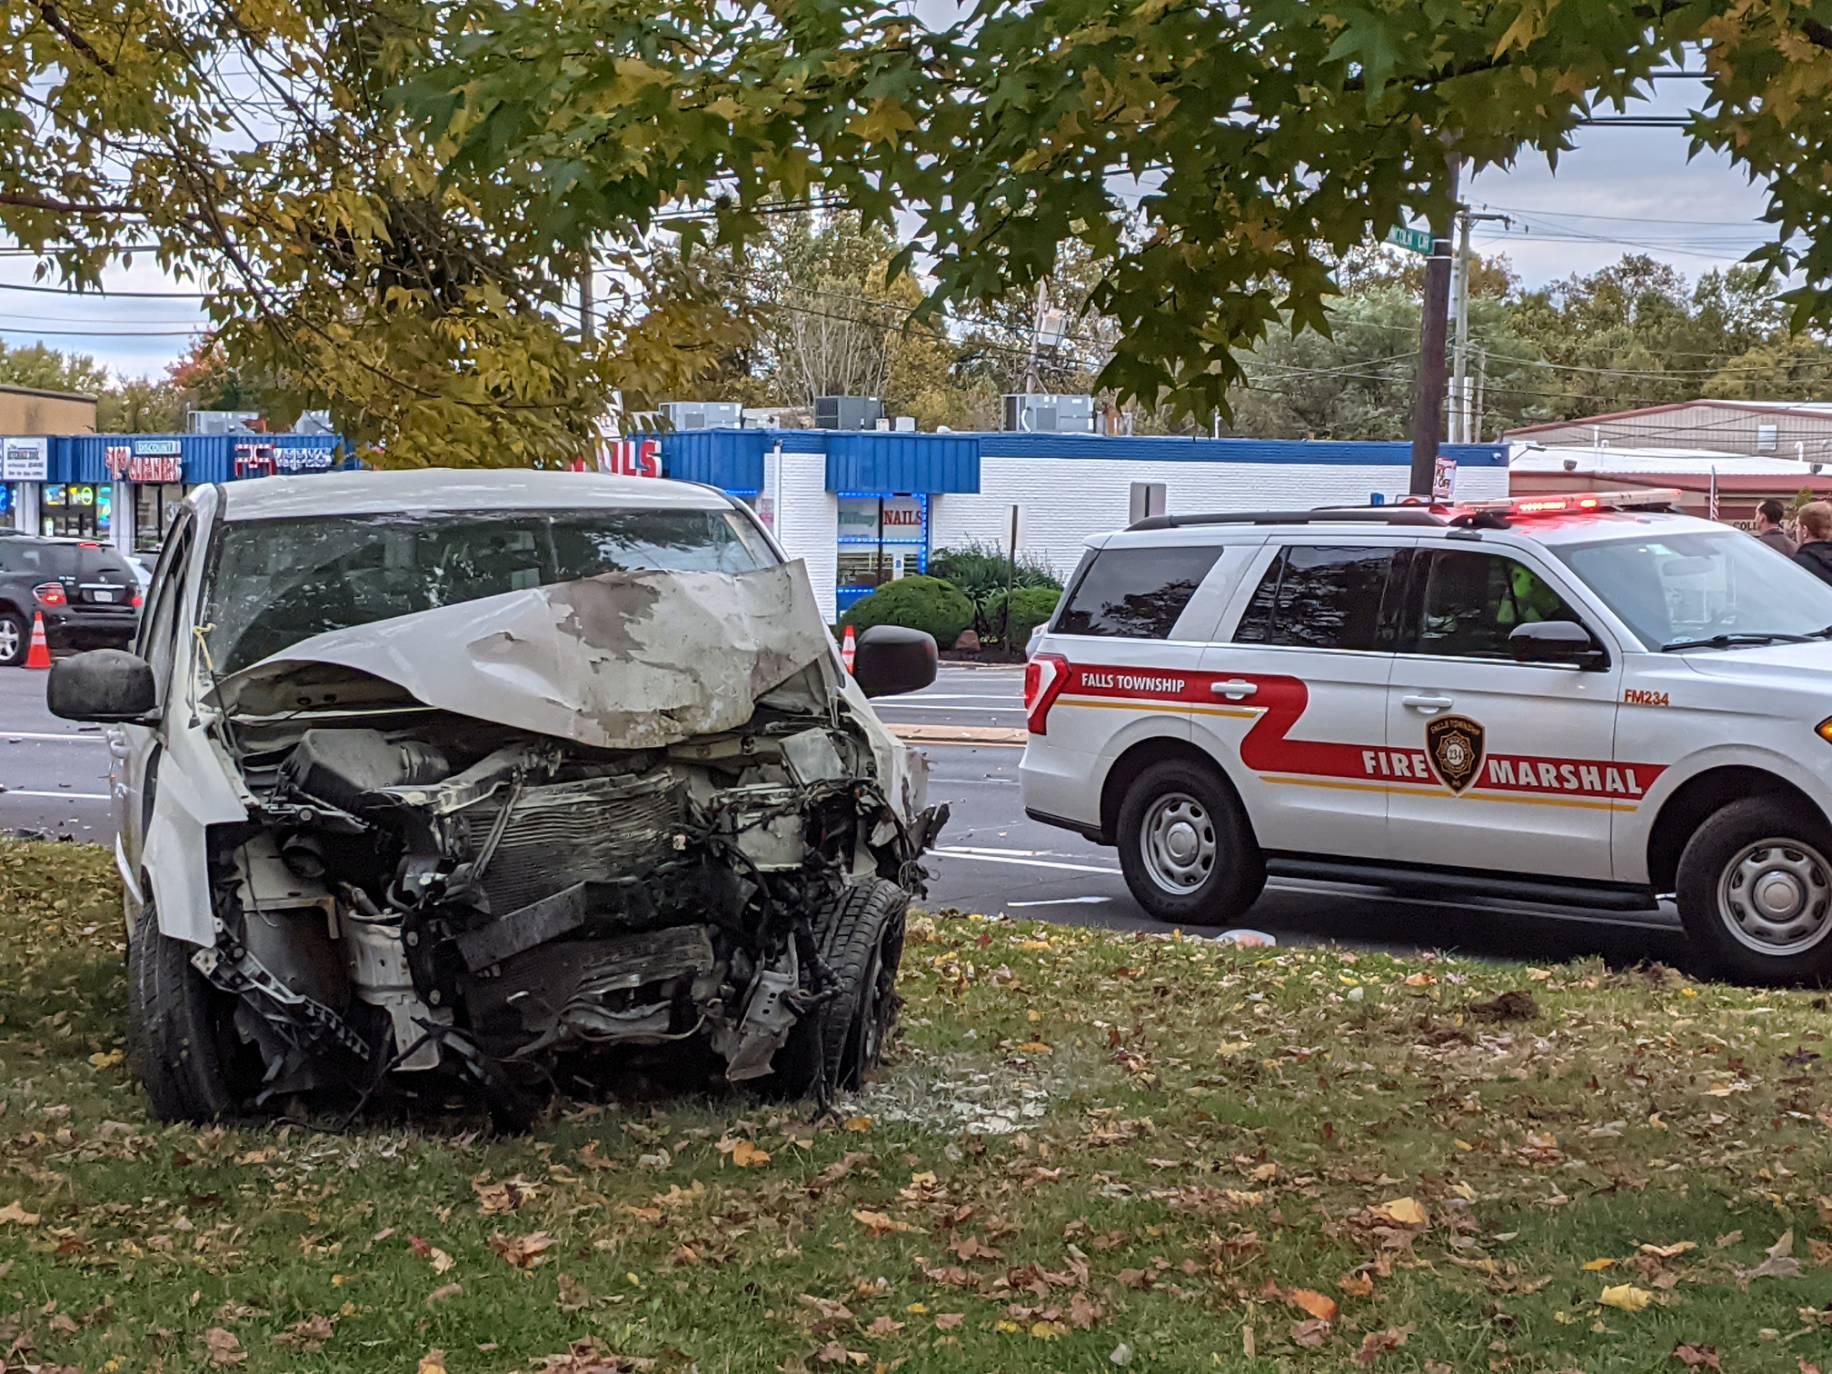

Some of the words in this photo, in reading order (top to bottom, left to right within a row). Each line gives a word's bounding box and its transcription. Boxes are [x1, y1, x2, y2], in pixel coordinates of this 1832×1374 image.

[883, 510, 922, 526] NAILS
[1732, 521, 1761, 531] COLL
[1081, 672, 1114, 688] FALLS
[1116, 675, 1185, 693] TOWNSHIP
[1624, 688, 1670, 706] FM234
[1361, 750, 1430, 779] FIRE
[1487, 758, 1643, 794] MARSHAL
